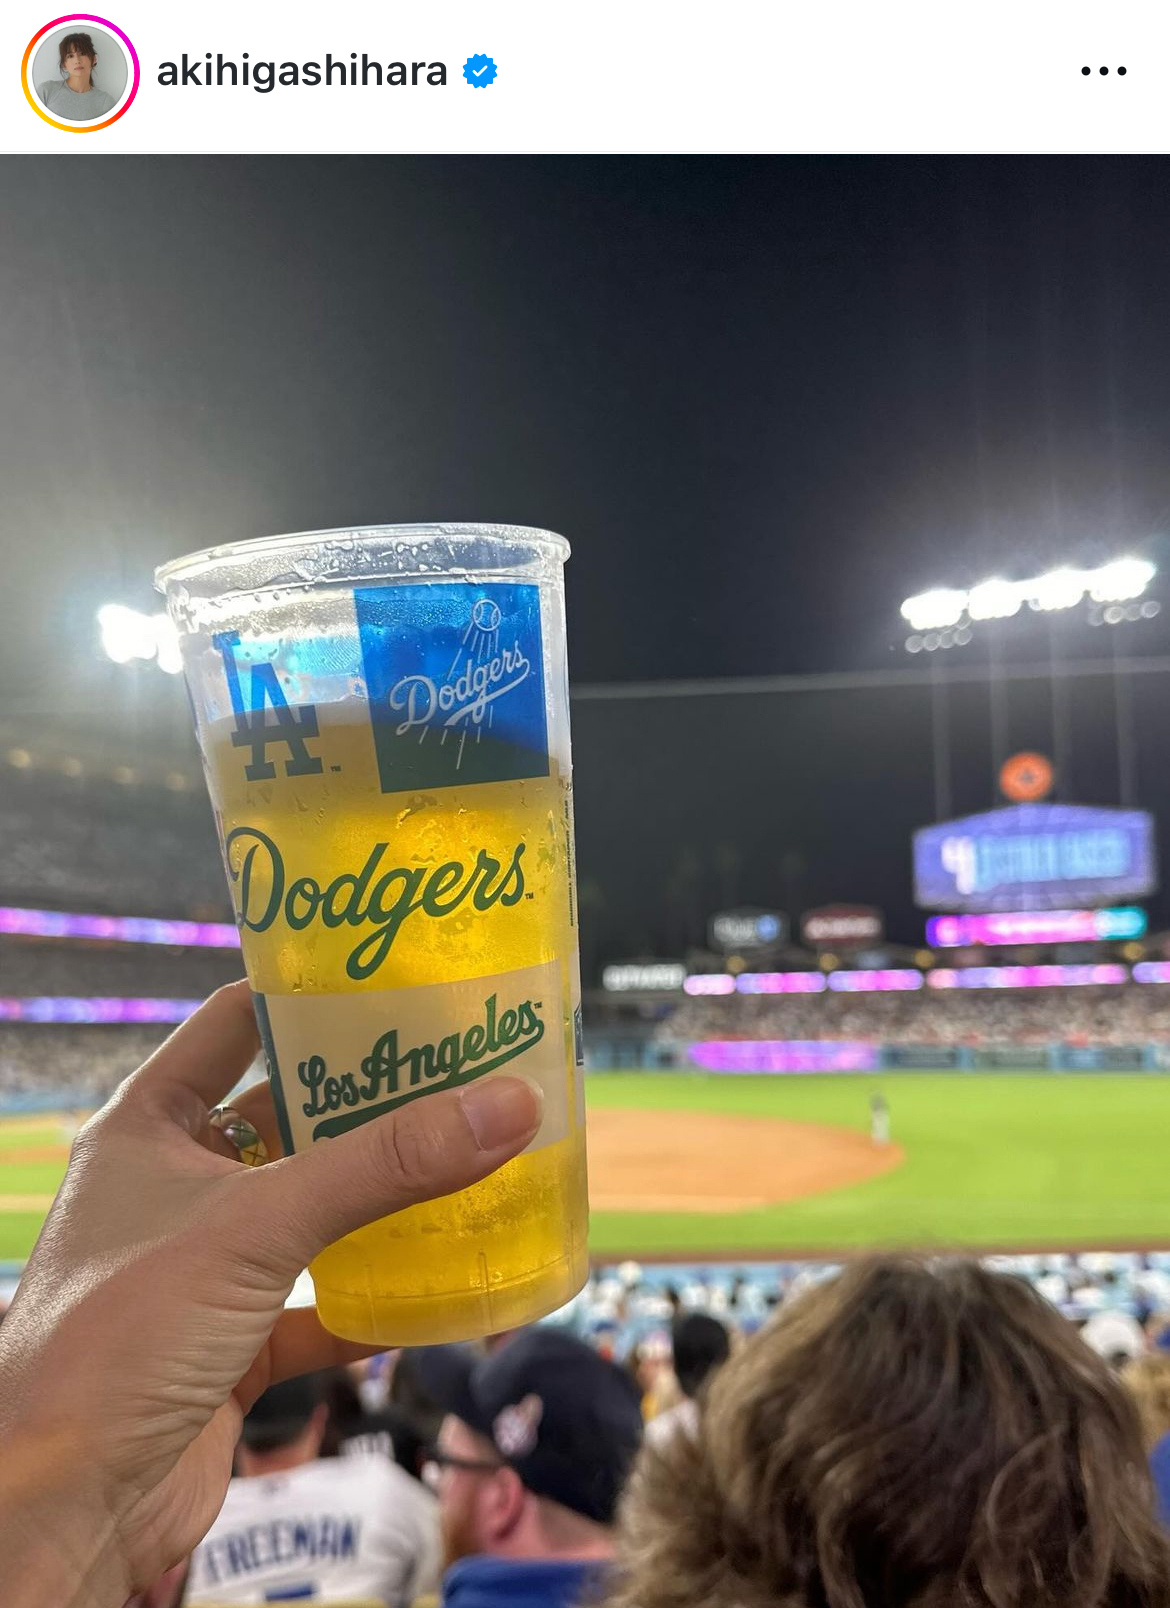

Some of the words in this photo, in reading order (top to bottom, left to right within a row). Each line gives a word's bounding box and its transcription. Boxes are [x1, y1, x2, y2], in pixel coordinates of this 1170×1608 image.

[212, 629, 324, 782] LA
[389, 640, 531, 736] Dodgers
[226, 826, 526, 980] Dodgers
[297, 1054, 361, 1118] Los
[359, 992, 544, 1101] Angeles
[203, 1514, 362, 1585] FREEMAN
